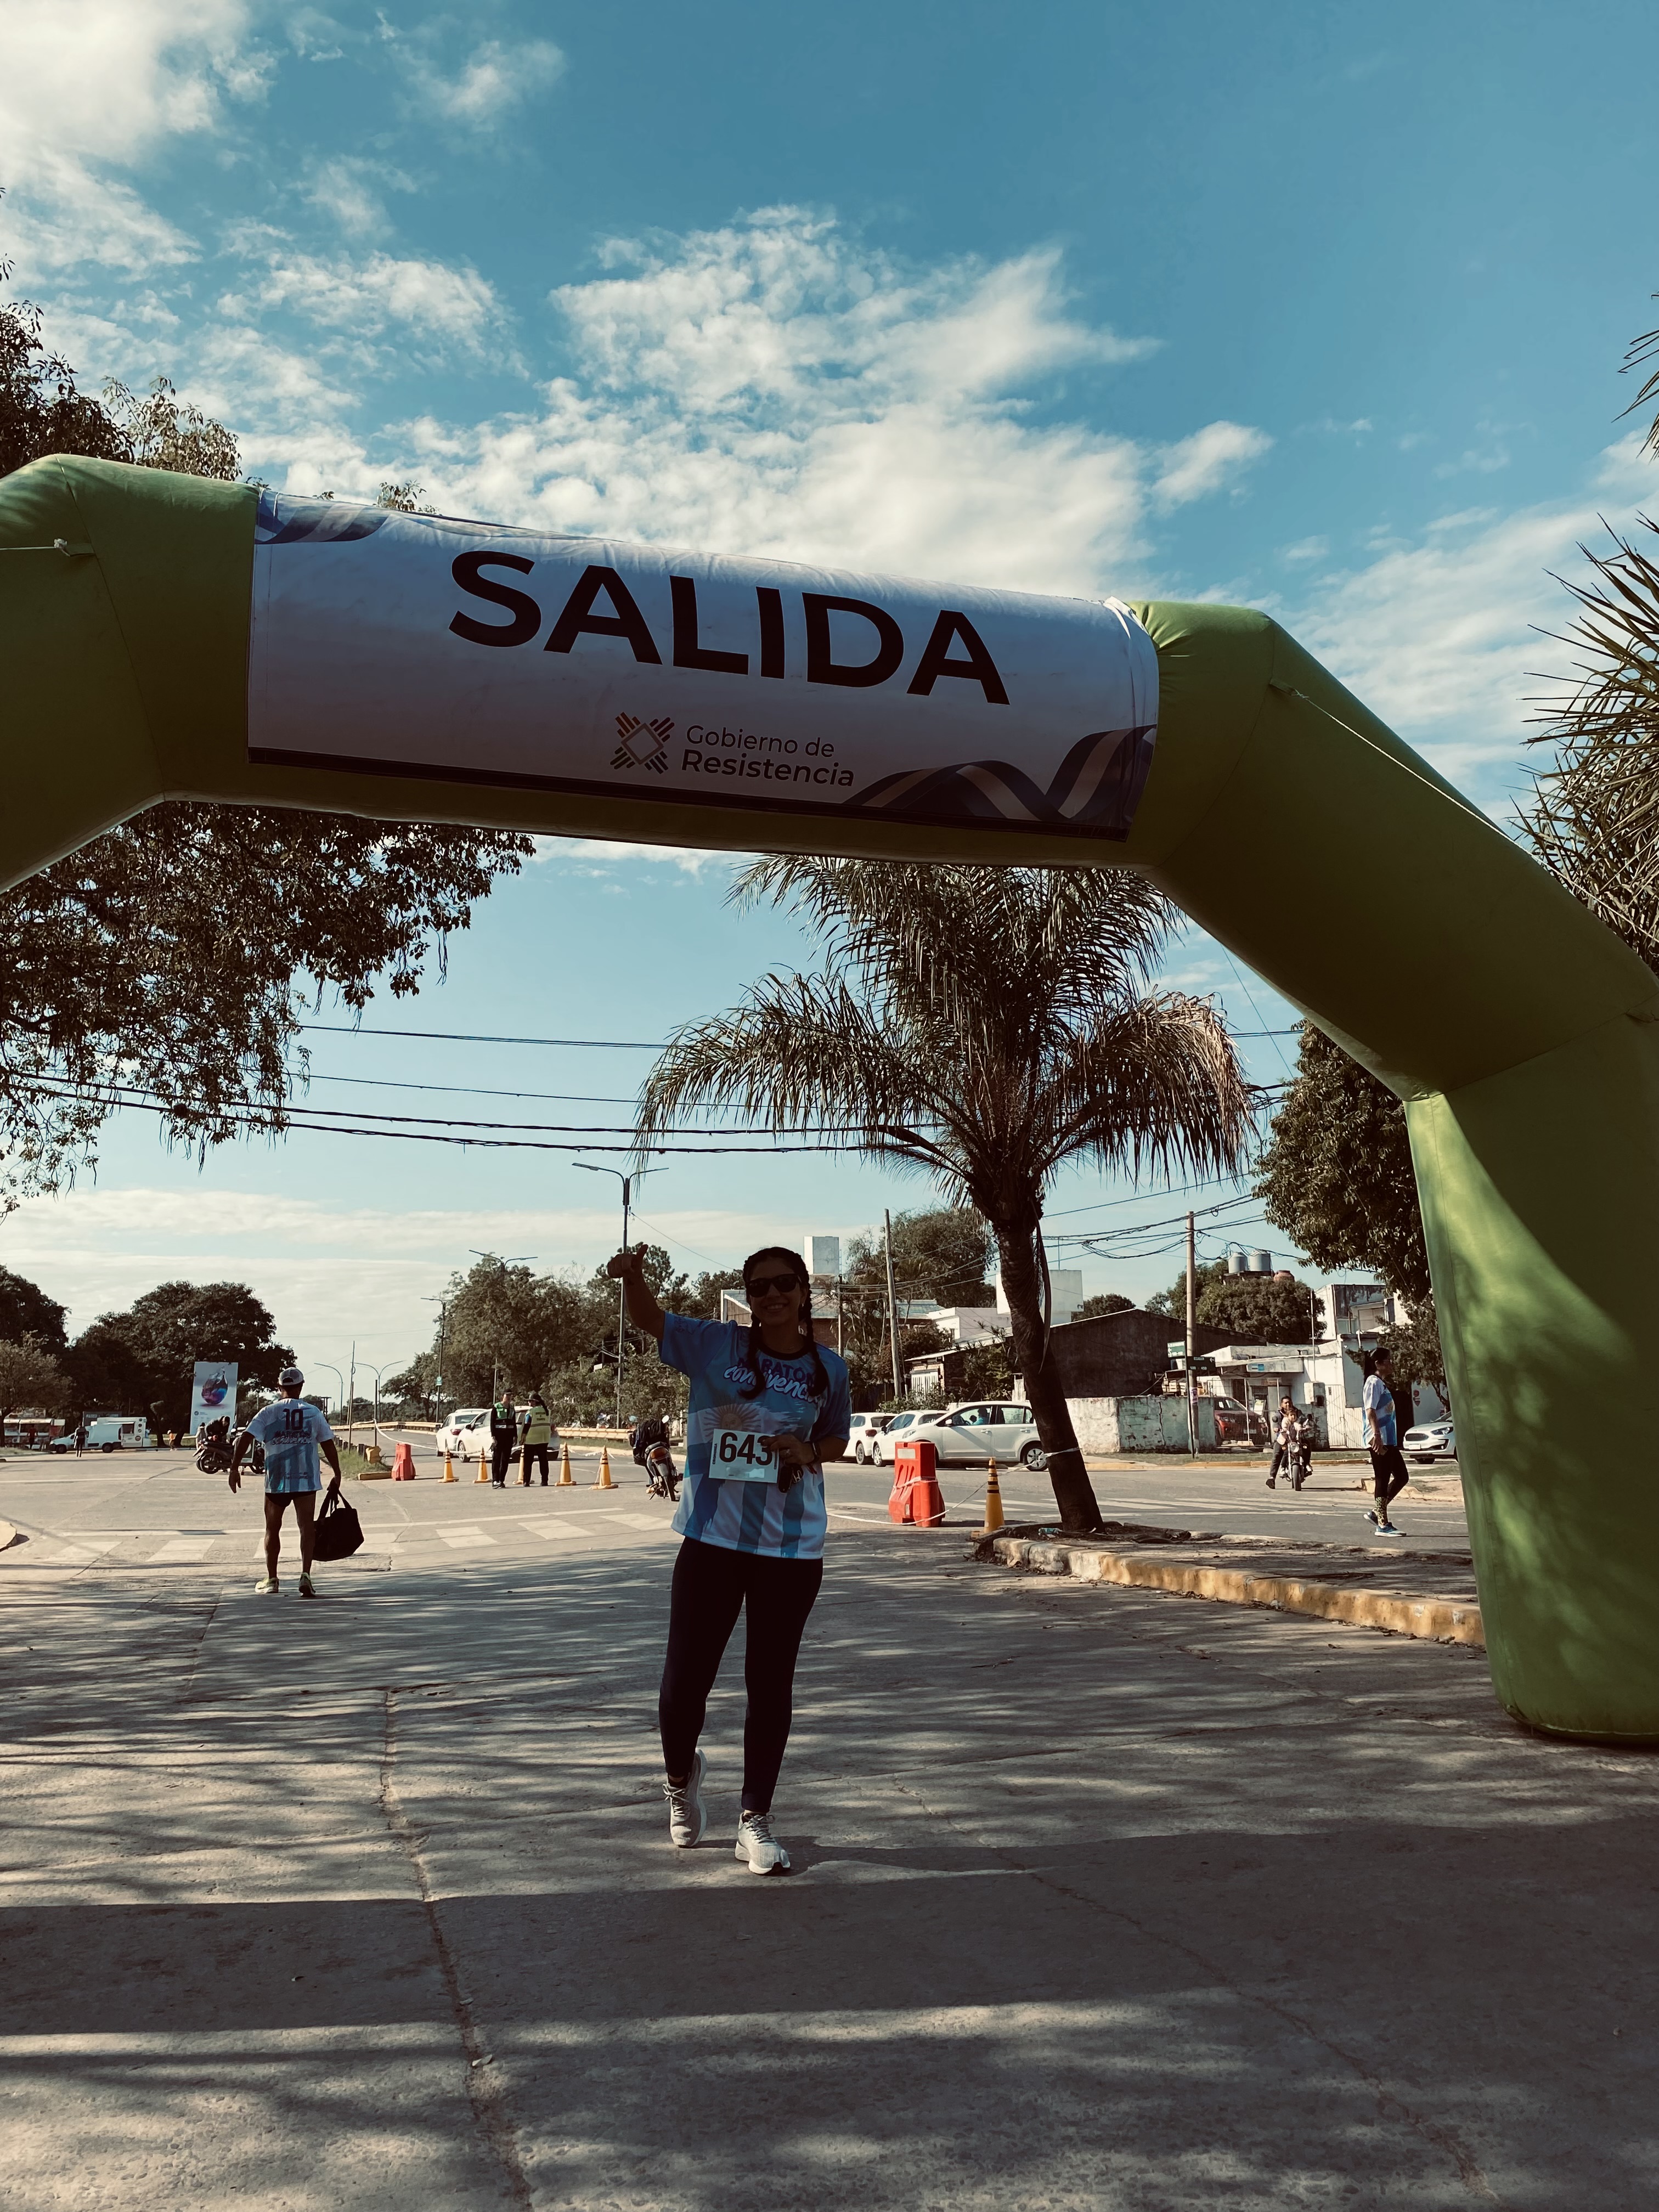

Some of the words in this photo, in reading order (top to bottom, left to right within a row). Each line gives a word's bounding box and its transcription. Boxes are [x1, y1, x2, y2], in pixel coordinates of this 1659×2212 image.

[448, 550, 1011, 706] SALIDA
[686, 725, 798, 754] Gobierno
[805, 737, 835, 758] de
[681, 748, 854, 787] Resistencia
[283, 1408, 304, 1431] 10
[719, 1431, 773, 1466] 643
